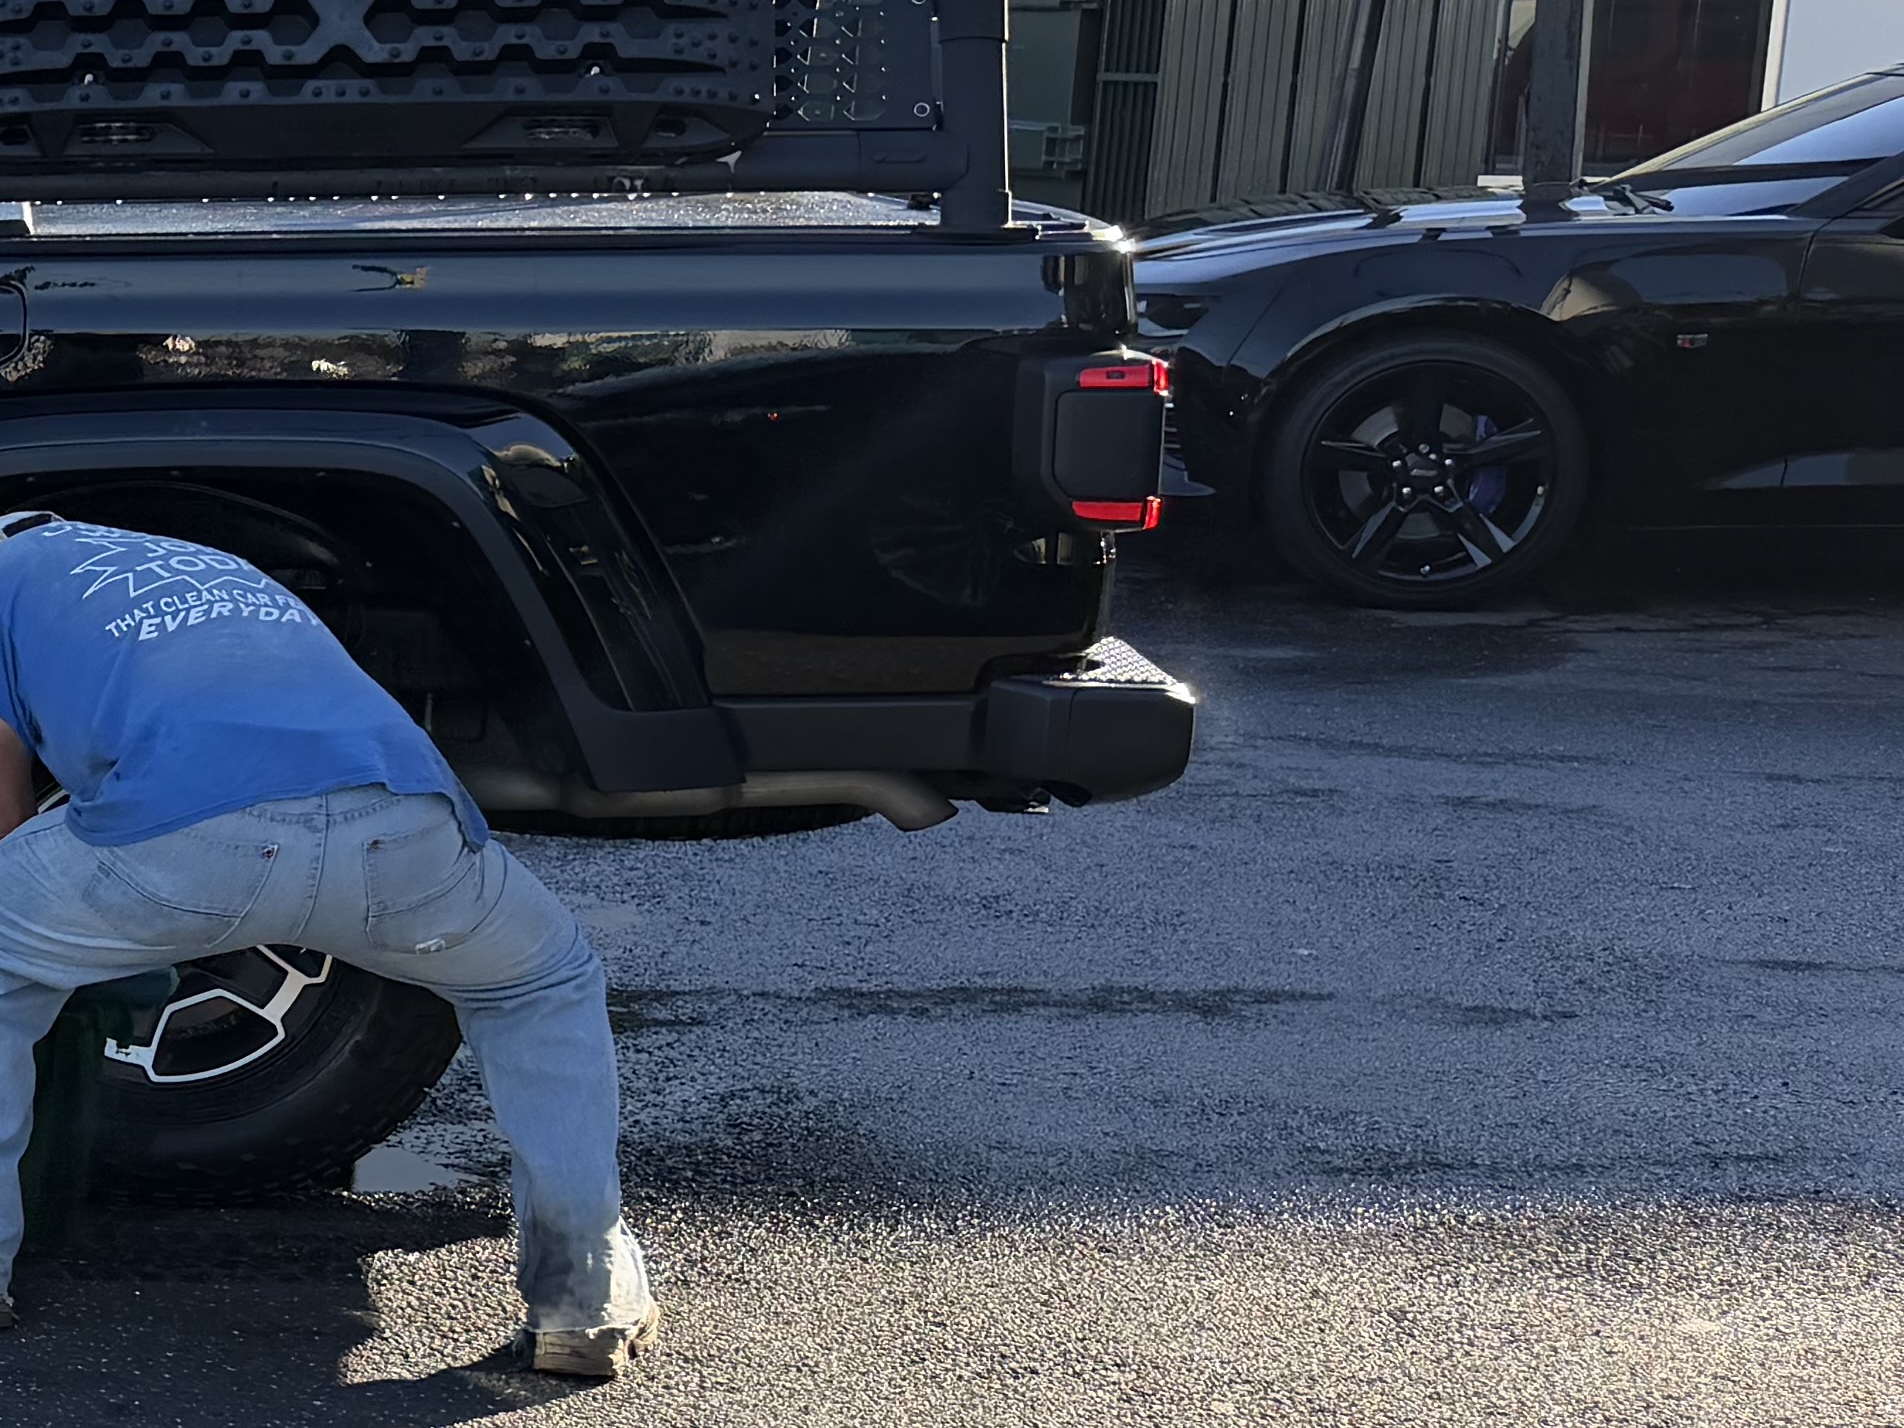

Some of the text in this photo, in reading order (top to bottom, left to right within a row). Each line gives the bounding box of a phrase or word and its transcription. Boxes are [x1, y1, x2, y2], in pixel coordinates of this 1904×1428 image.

[105, 600, 155, 638] THAT
[160, 588, 228, 612] CLEAN
[233, 589, 272, 608] CAR
